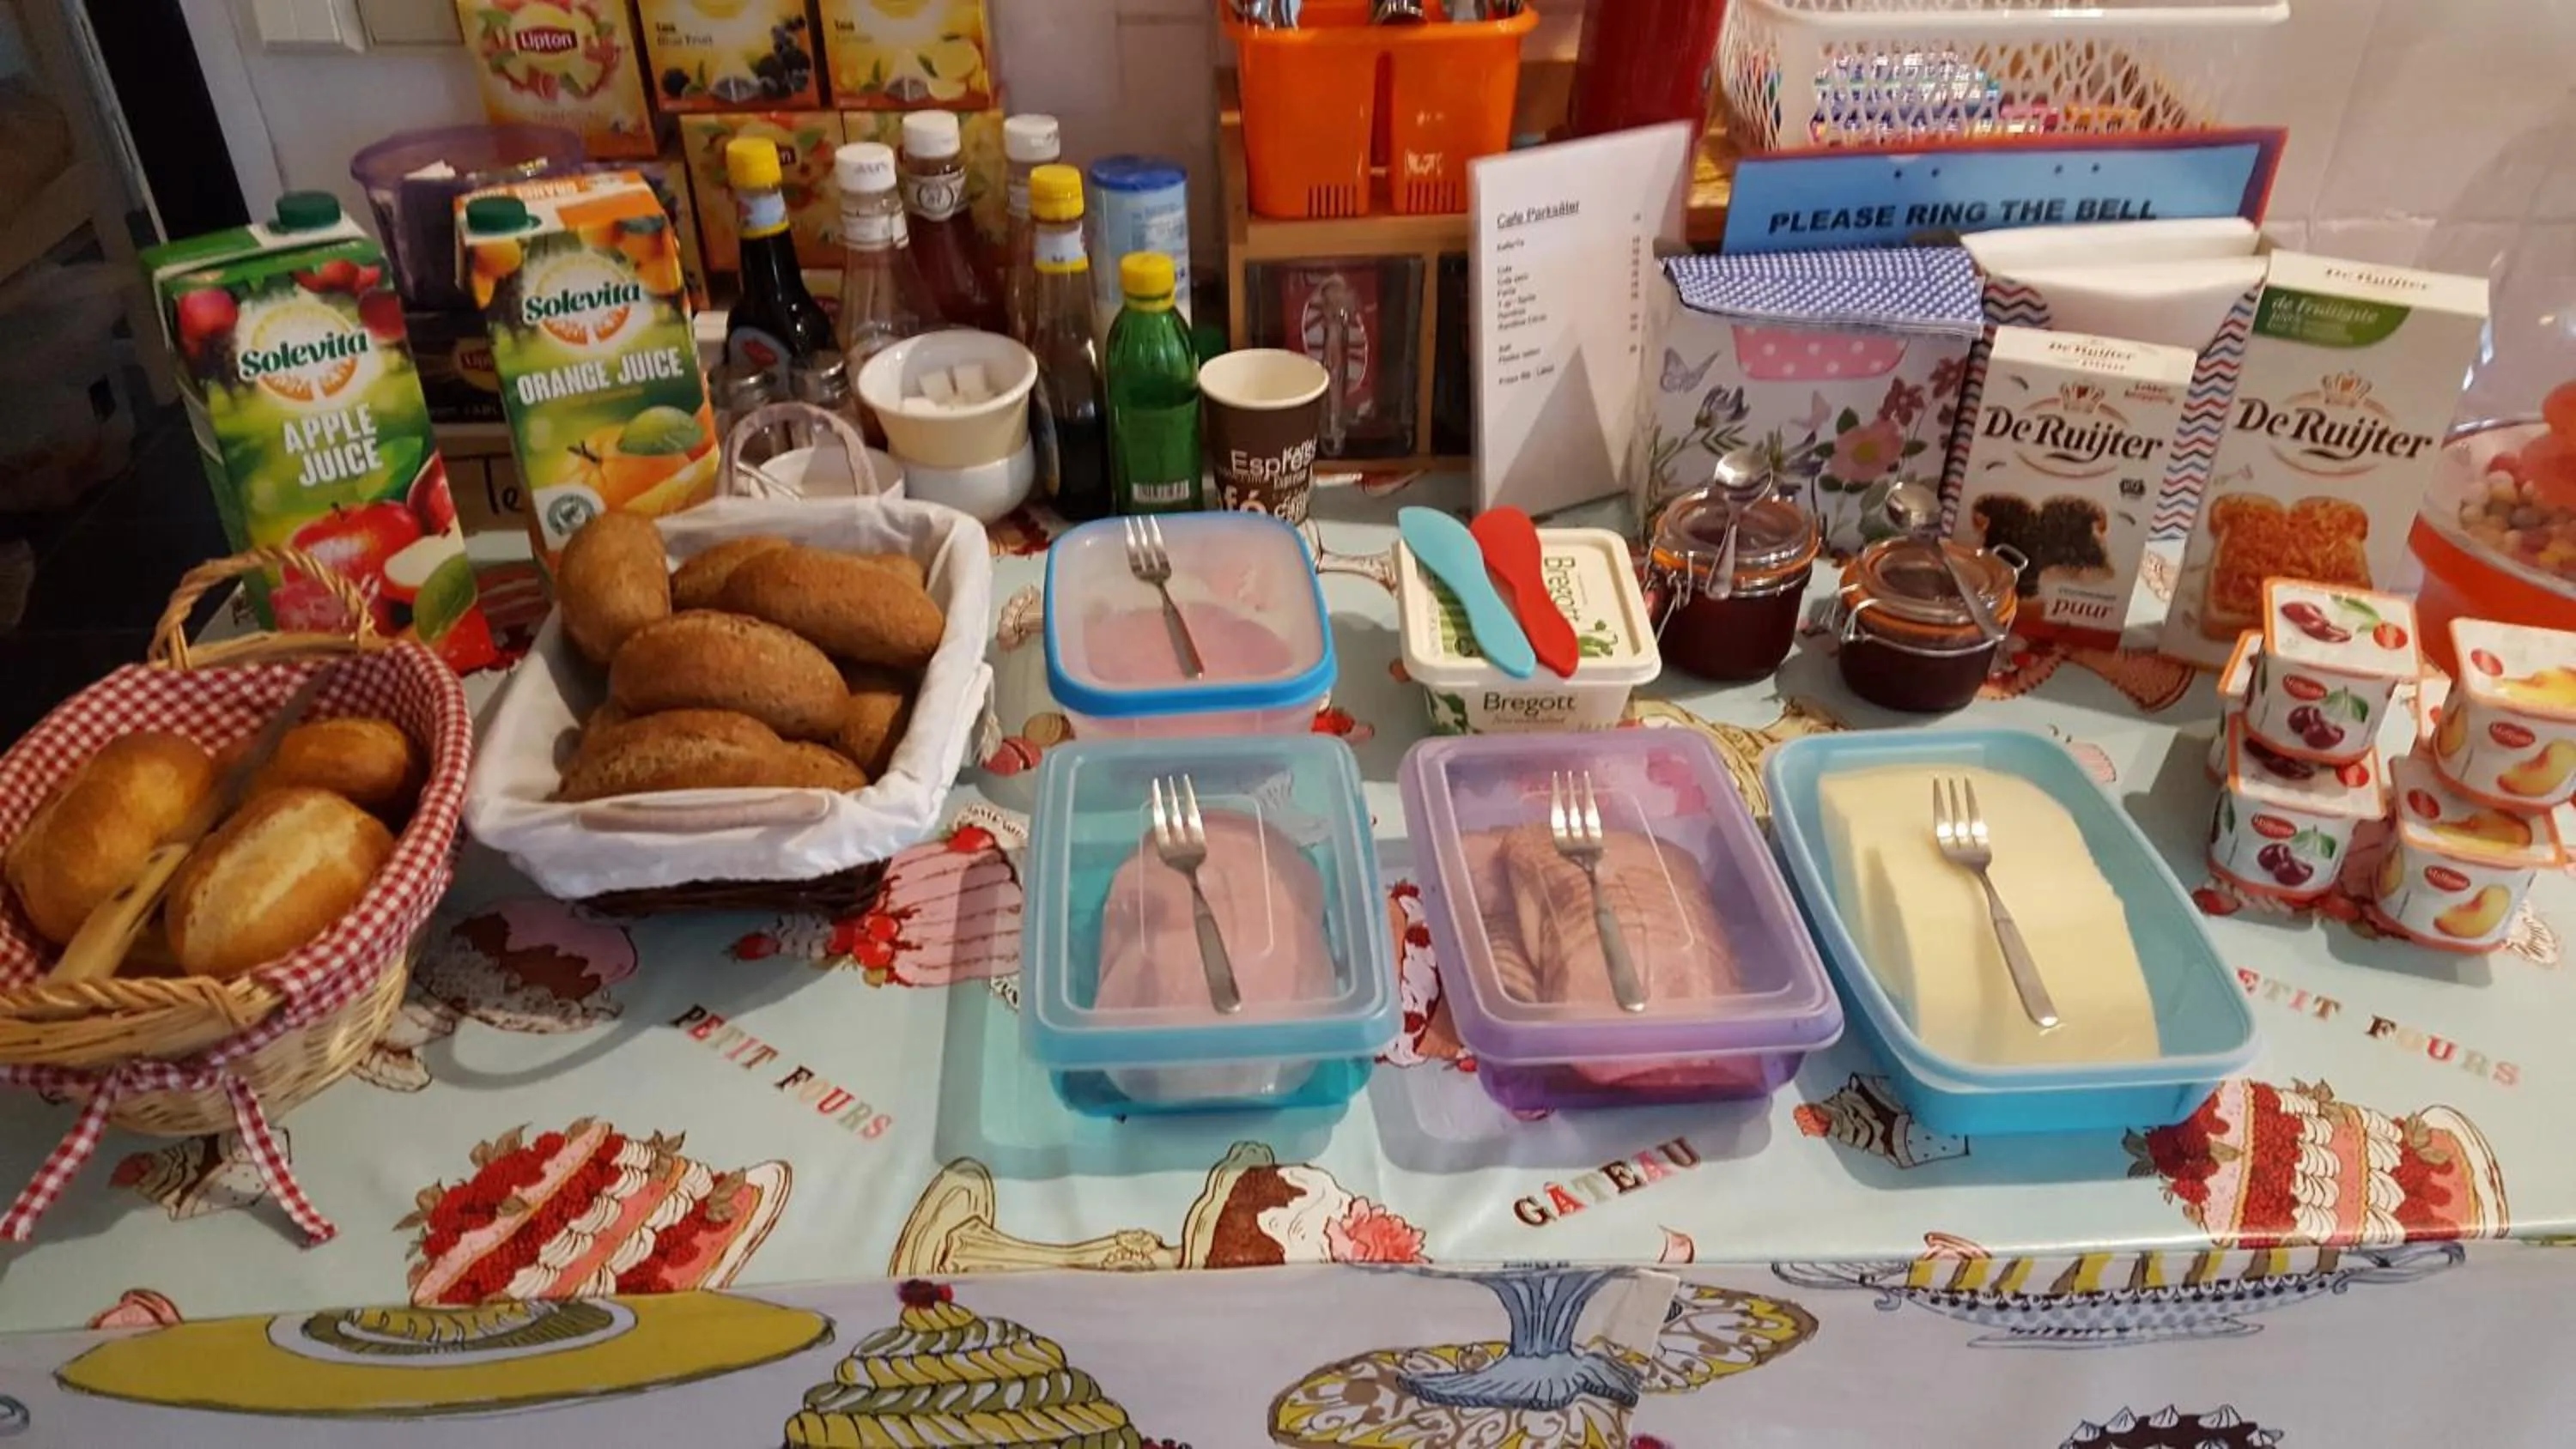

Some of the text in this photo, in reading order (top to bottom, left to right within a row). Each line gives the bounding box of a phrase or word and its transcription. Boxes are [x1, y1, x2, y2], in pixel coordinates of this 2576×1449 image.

[519, 31, 573, 52] Lipton
[1767, 196, 2157, 235] PLEASE RING THE BELL
[525, 282, 641, 321] Solevita
[240, 331, 368, 378] Solevita
[517, 346, 684, 406] ORANGE JUICE
[283, 403, 377, 455] APPLE
[1981, 405, 2164, 464] De Ruijter
[2235, 397, 2433, 461] De Ruijter
[299, 438, 384, 487] JUICE
[1484, 691, 1577, 717] Bregott
[2235, 967, 2521, 1088] ETIT FOURS
[668, 1003, 894, 1141] PETIT FOURS
[1513, 1136, 1702, 1228] GÂTEAU
